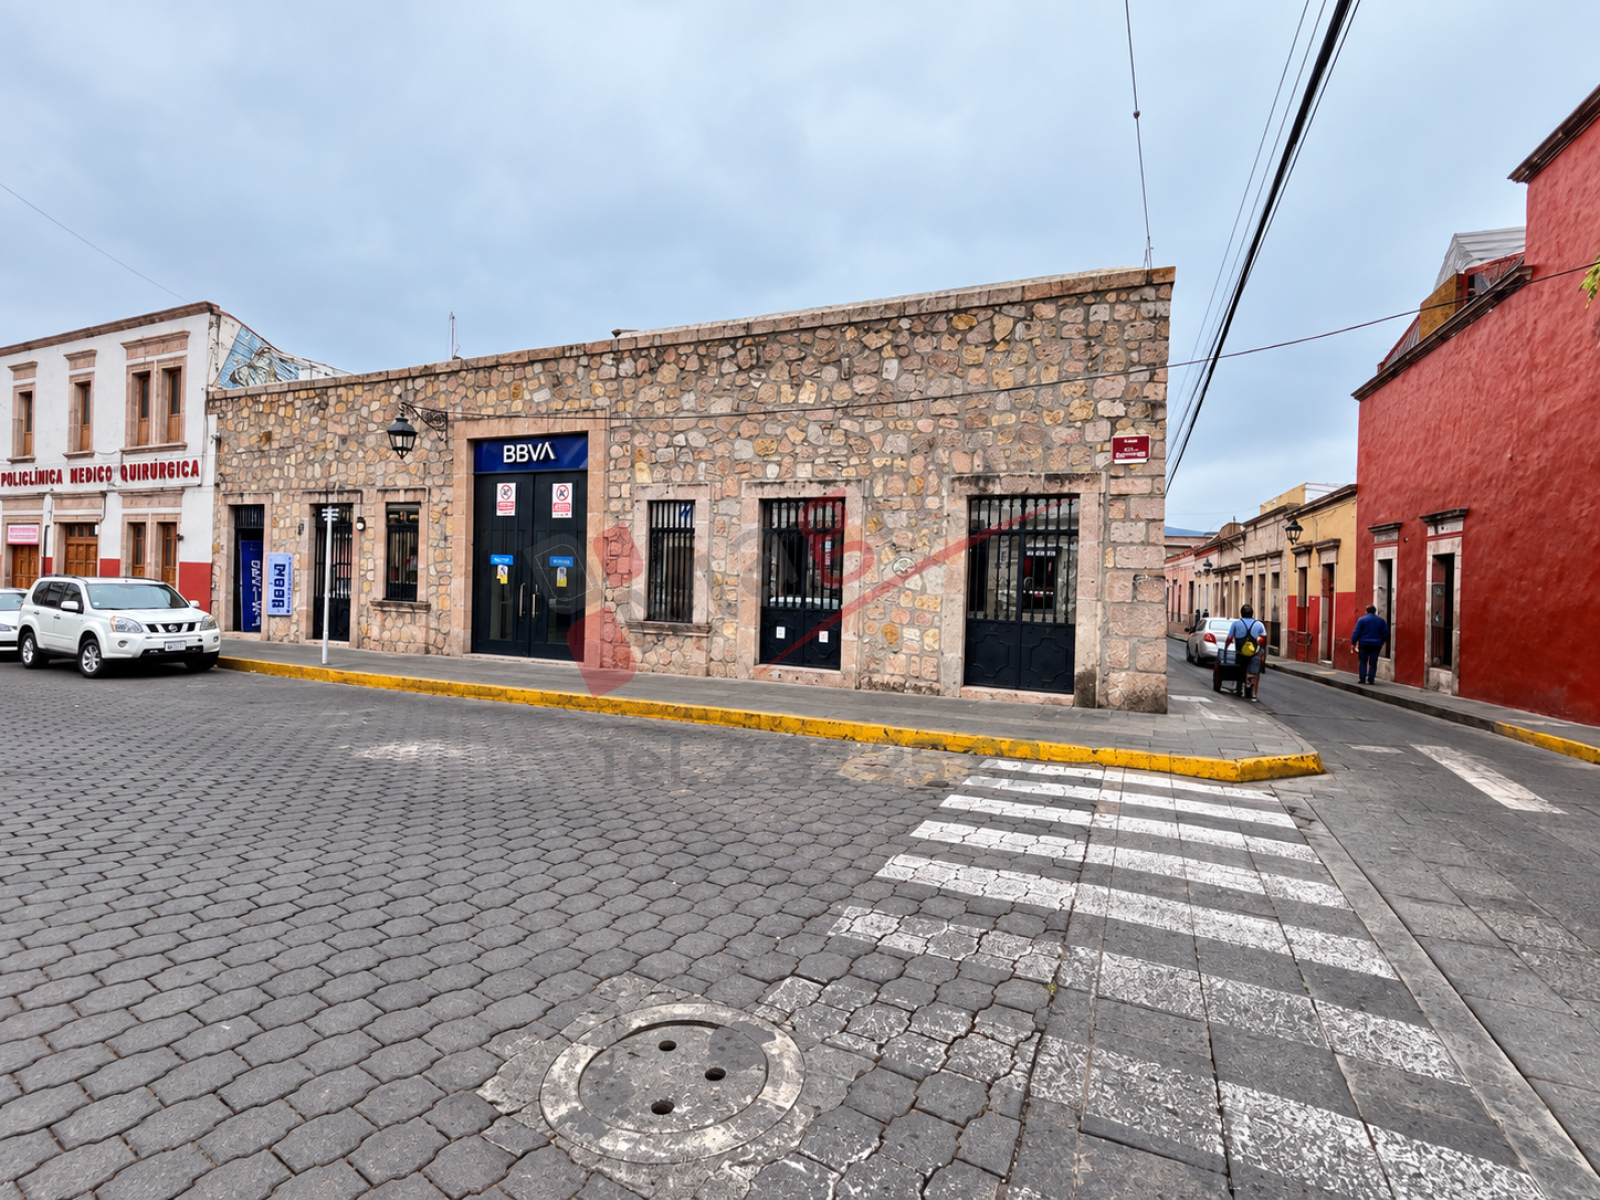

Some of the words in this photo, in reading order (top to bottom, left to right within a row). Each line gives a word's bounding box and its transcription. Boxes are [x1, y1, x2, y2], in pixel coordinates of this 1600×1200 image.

[503, 441, 556, 463] BBVA
[1, 466, 63, 487] POLICLÍNICA
[120, 457, 200, 483] QUIRÚRGICA
